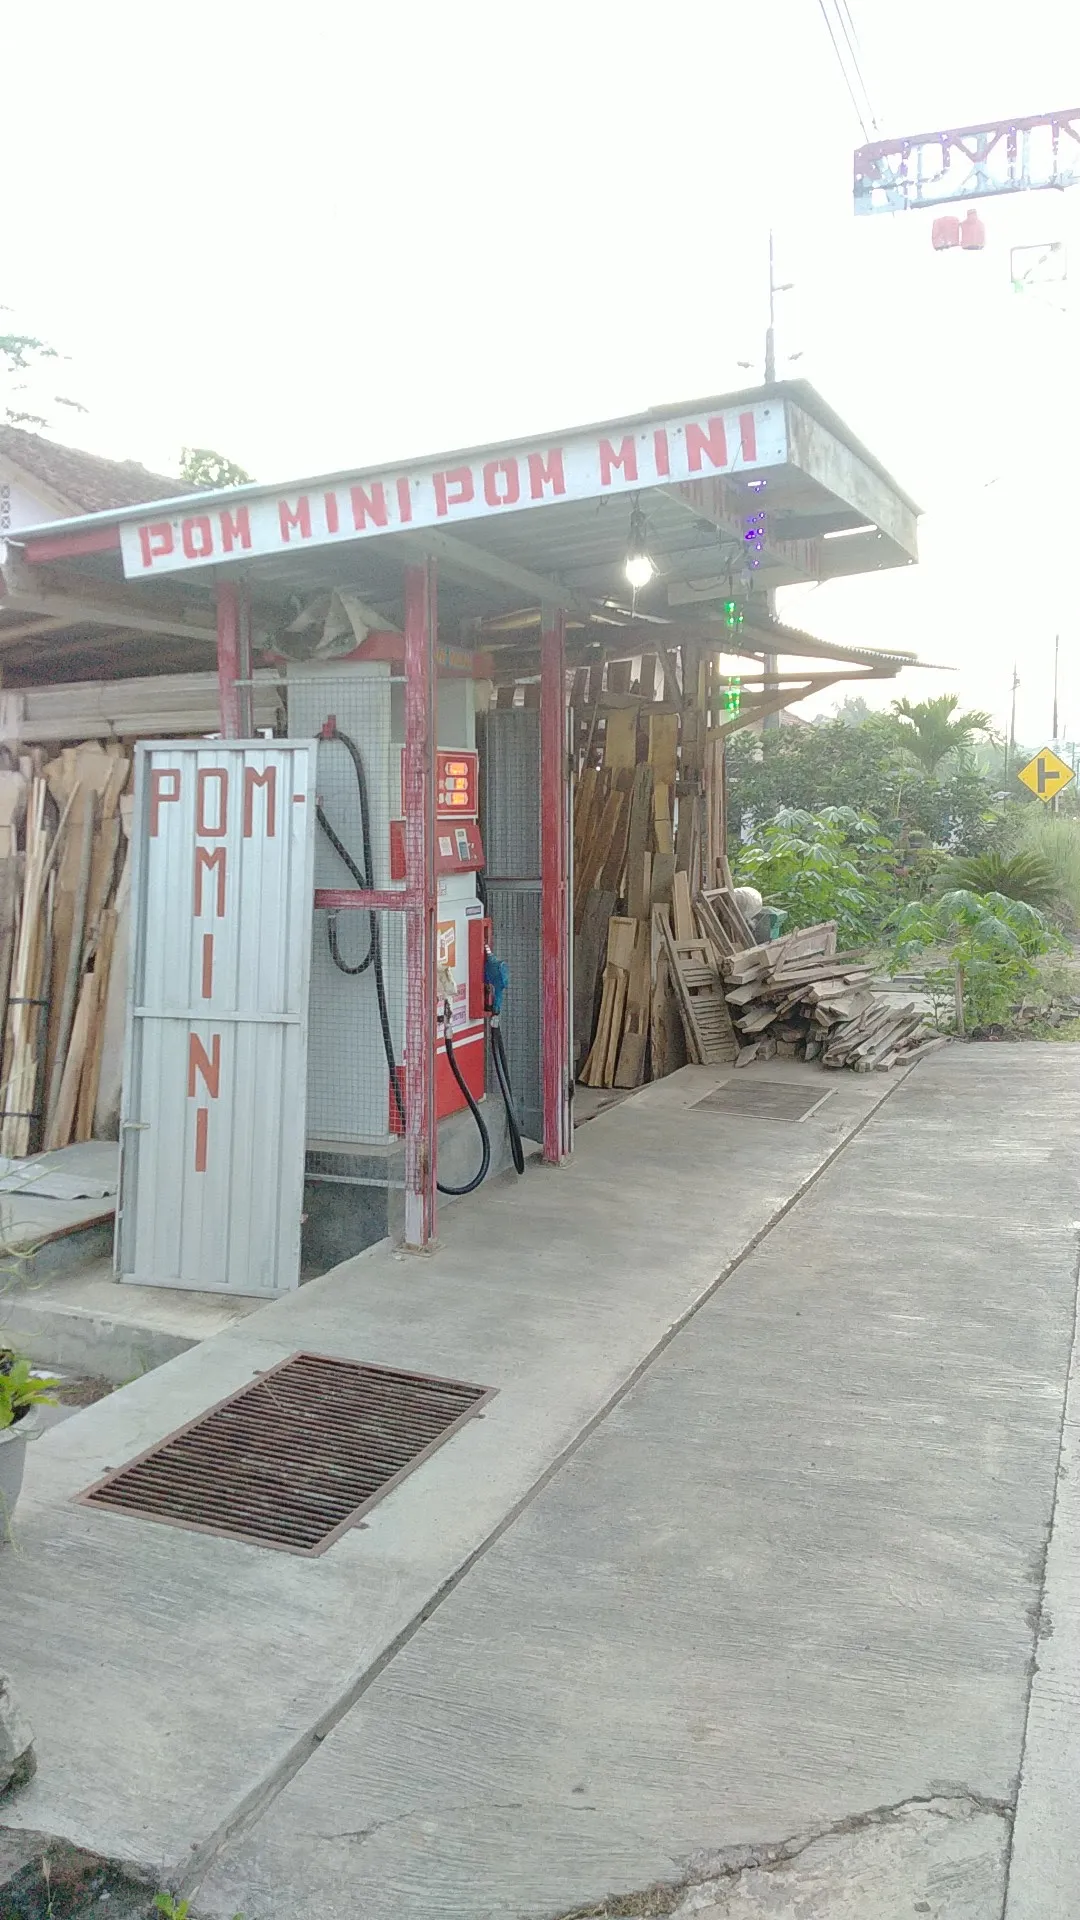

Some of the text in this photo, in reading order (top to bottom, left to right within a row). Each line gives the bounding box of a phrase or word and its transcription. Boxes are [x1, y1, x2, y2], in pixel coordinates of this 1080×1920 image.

[138, 412, 757, 567] POM MINI POM MINI
